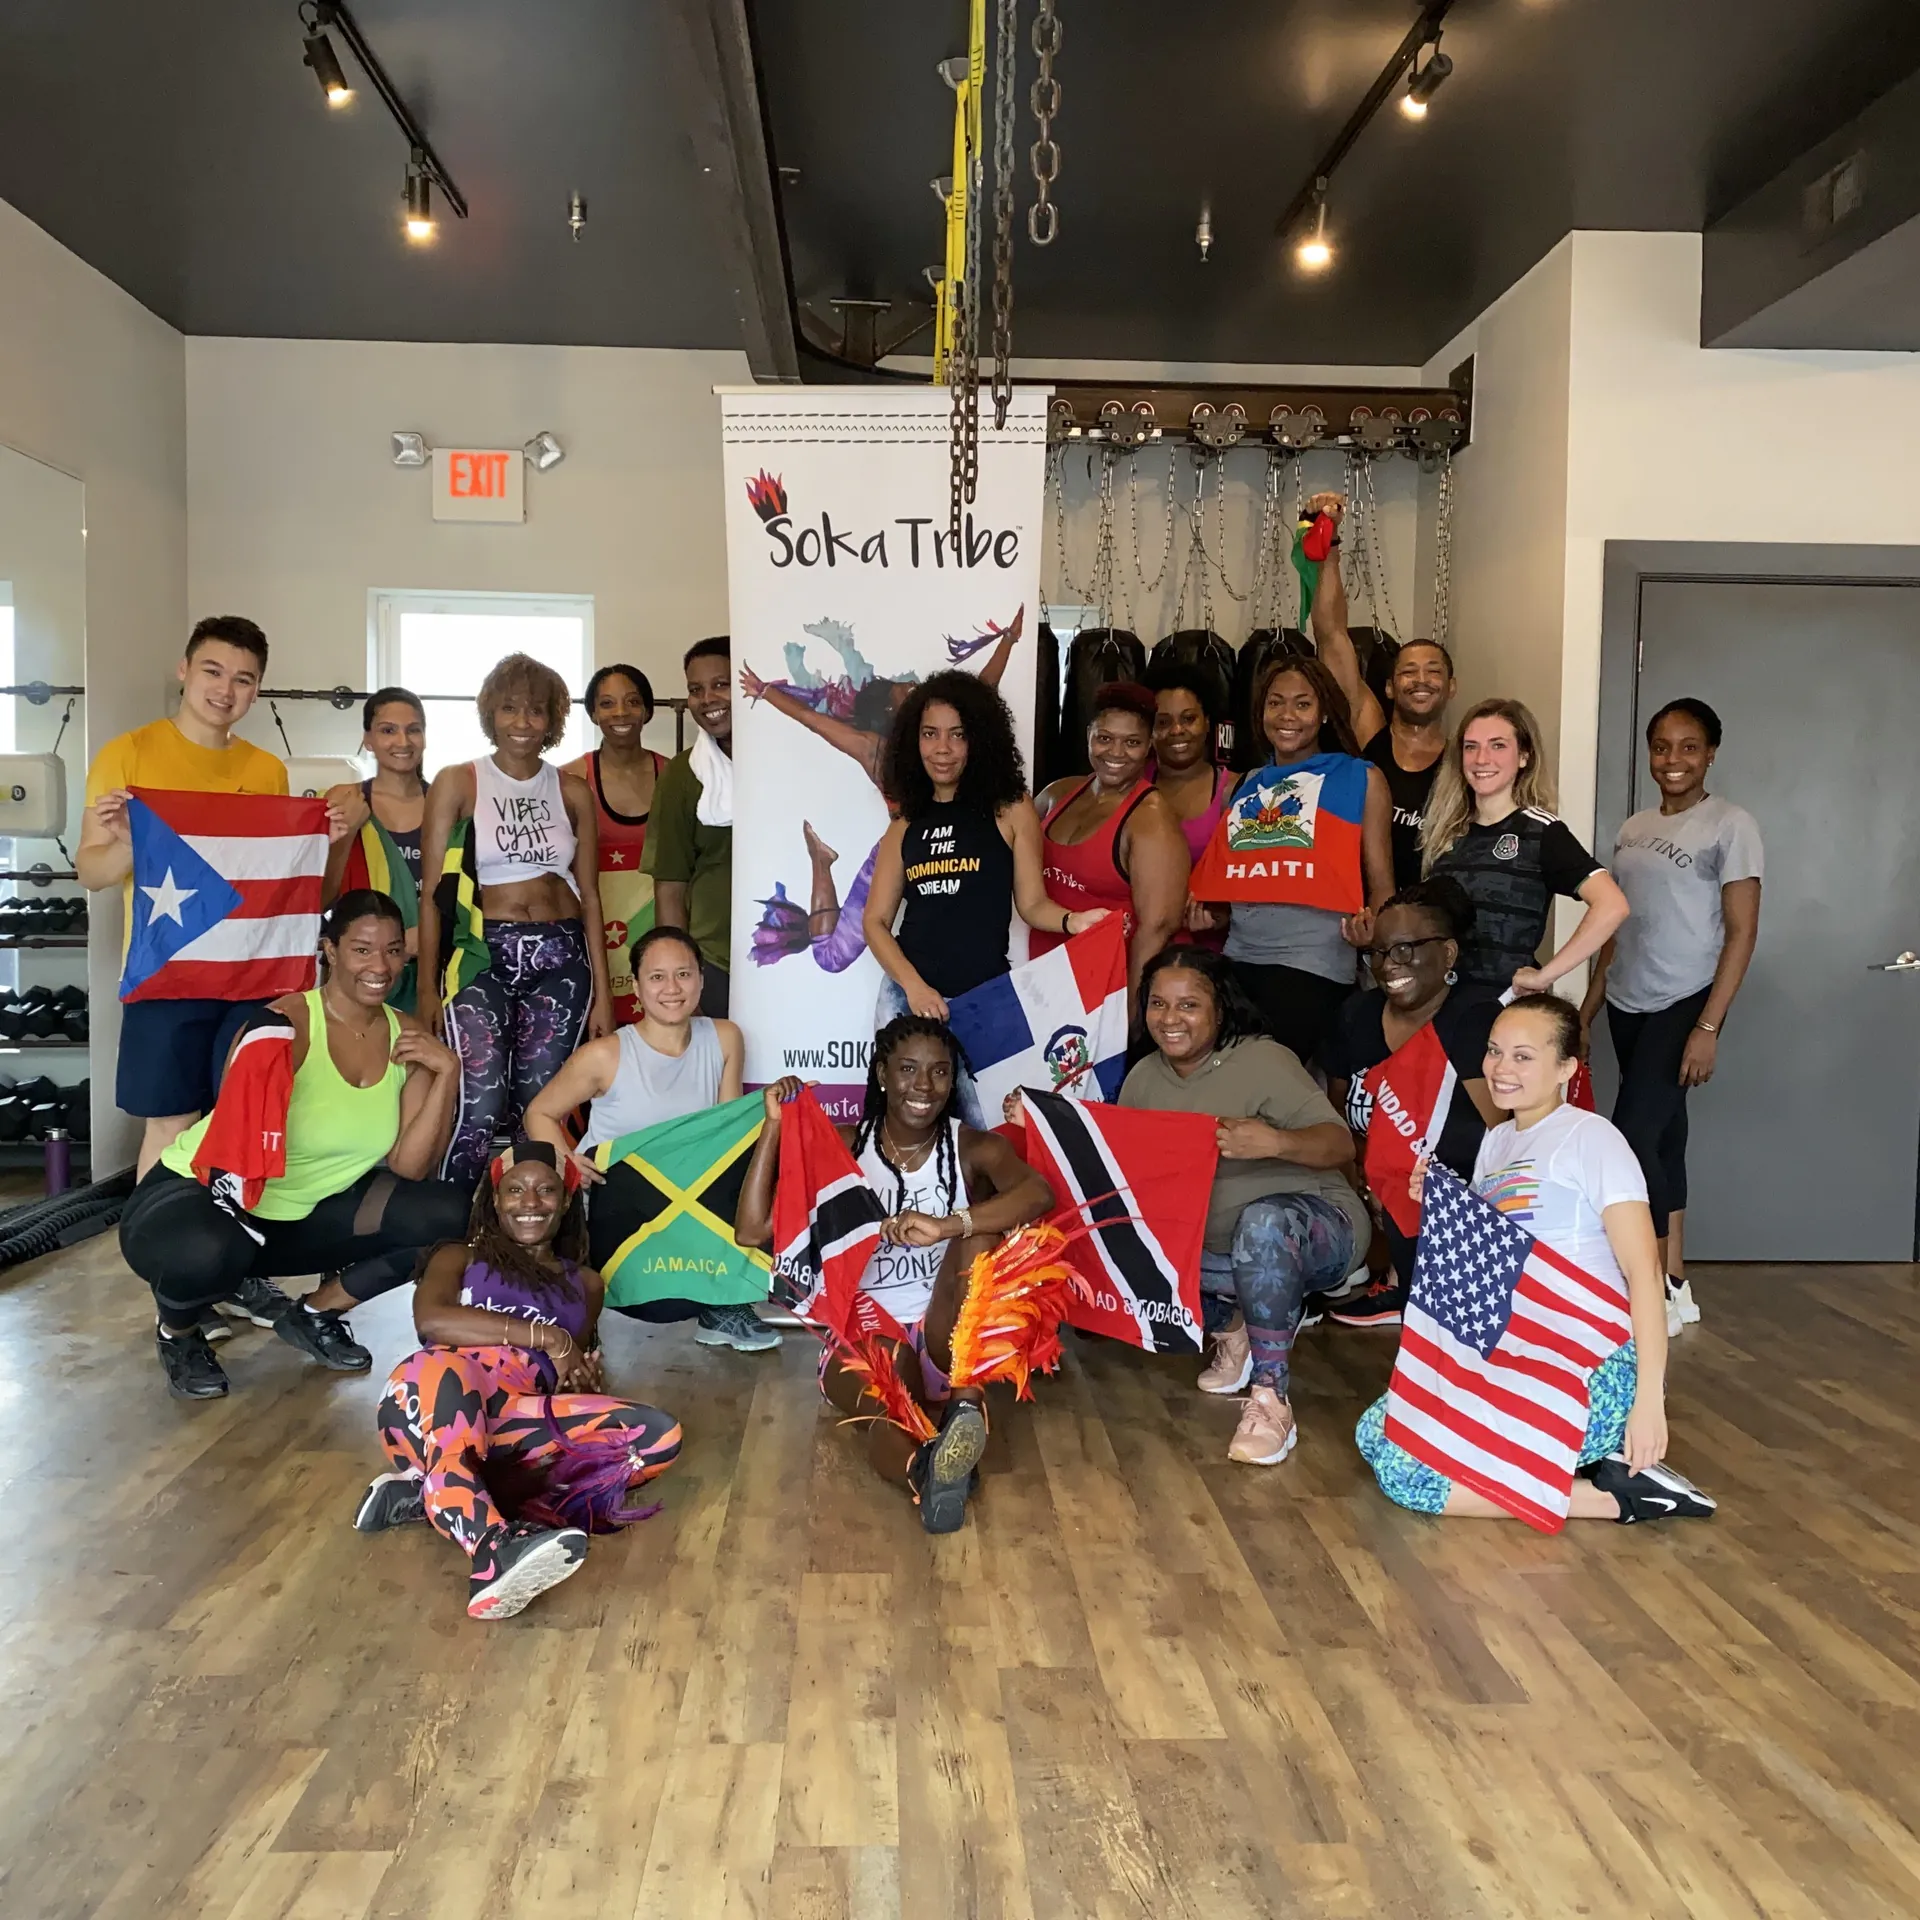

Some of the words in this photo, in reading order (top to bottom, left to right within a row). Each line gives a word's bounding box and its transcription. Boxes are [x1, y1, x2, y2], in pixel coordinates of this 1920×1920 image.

[450, 452, 509, 498] EXIT
[765, 511, 888, 568] Soka
[493, 796, 552, 823] VIBES
[922, 829, 929, 840] I
[930, 825, 953, 839] AM
[930, 840, 956, 855] THE
[906, 858, 980, 882] DOMINICAN
[1226, 861, 1314, 879] HAITI
[917, 879, 960, 895] DREAM
[643, 1257, 728, 1276] JAMAICA
[1137, 1299, 1194, 1327] TOBAGO
